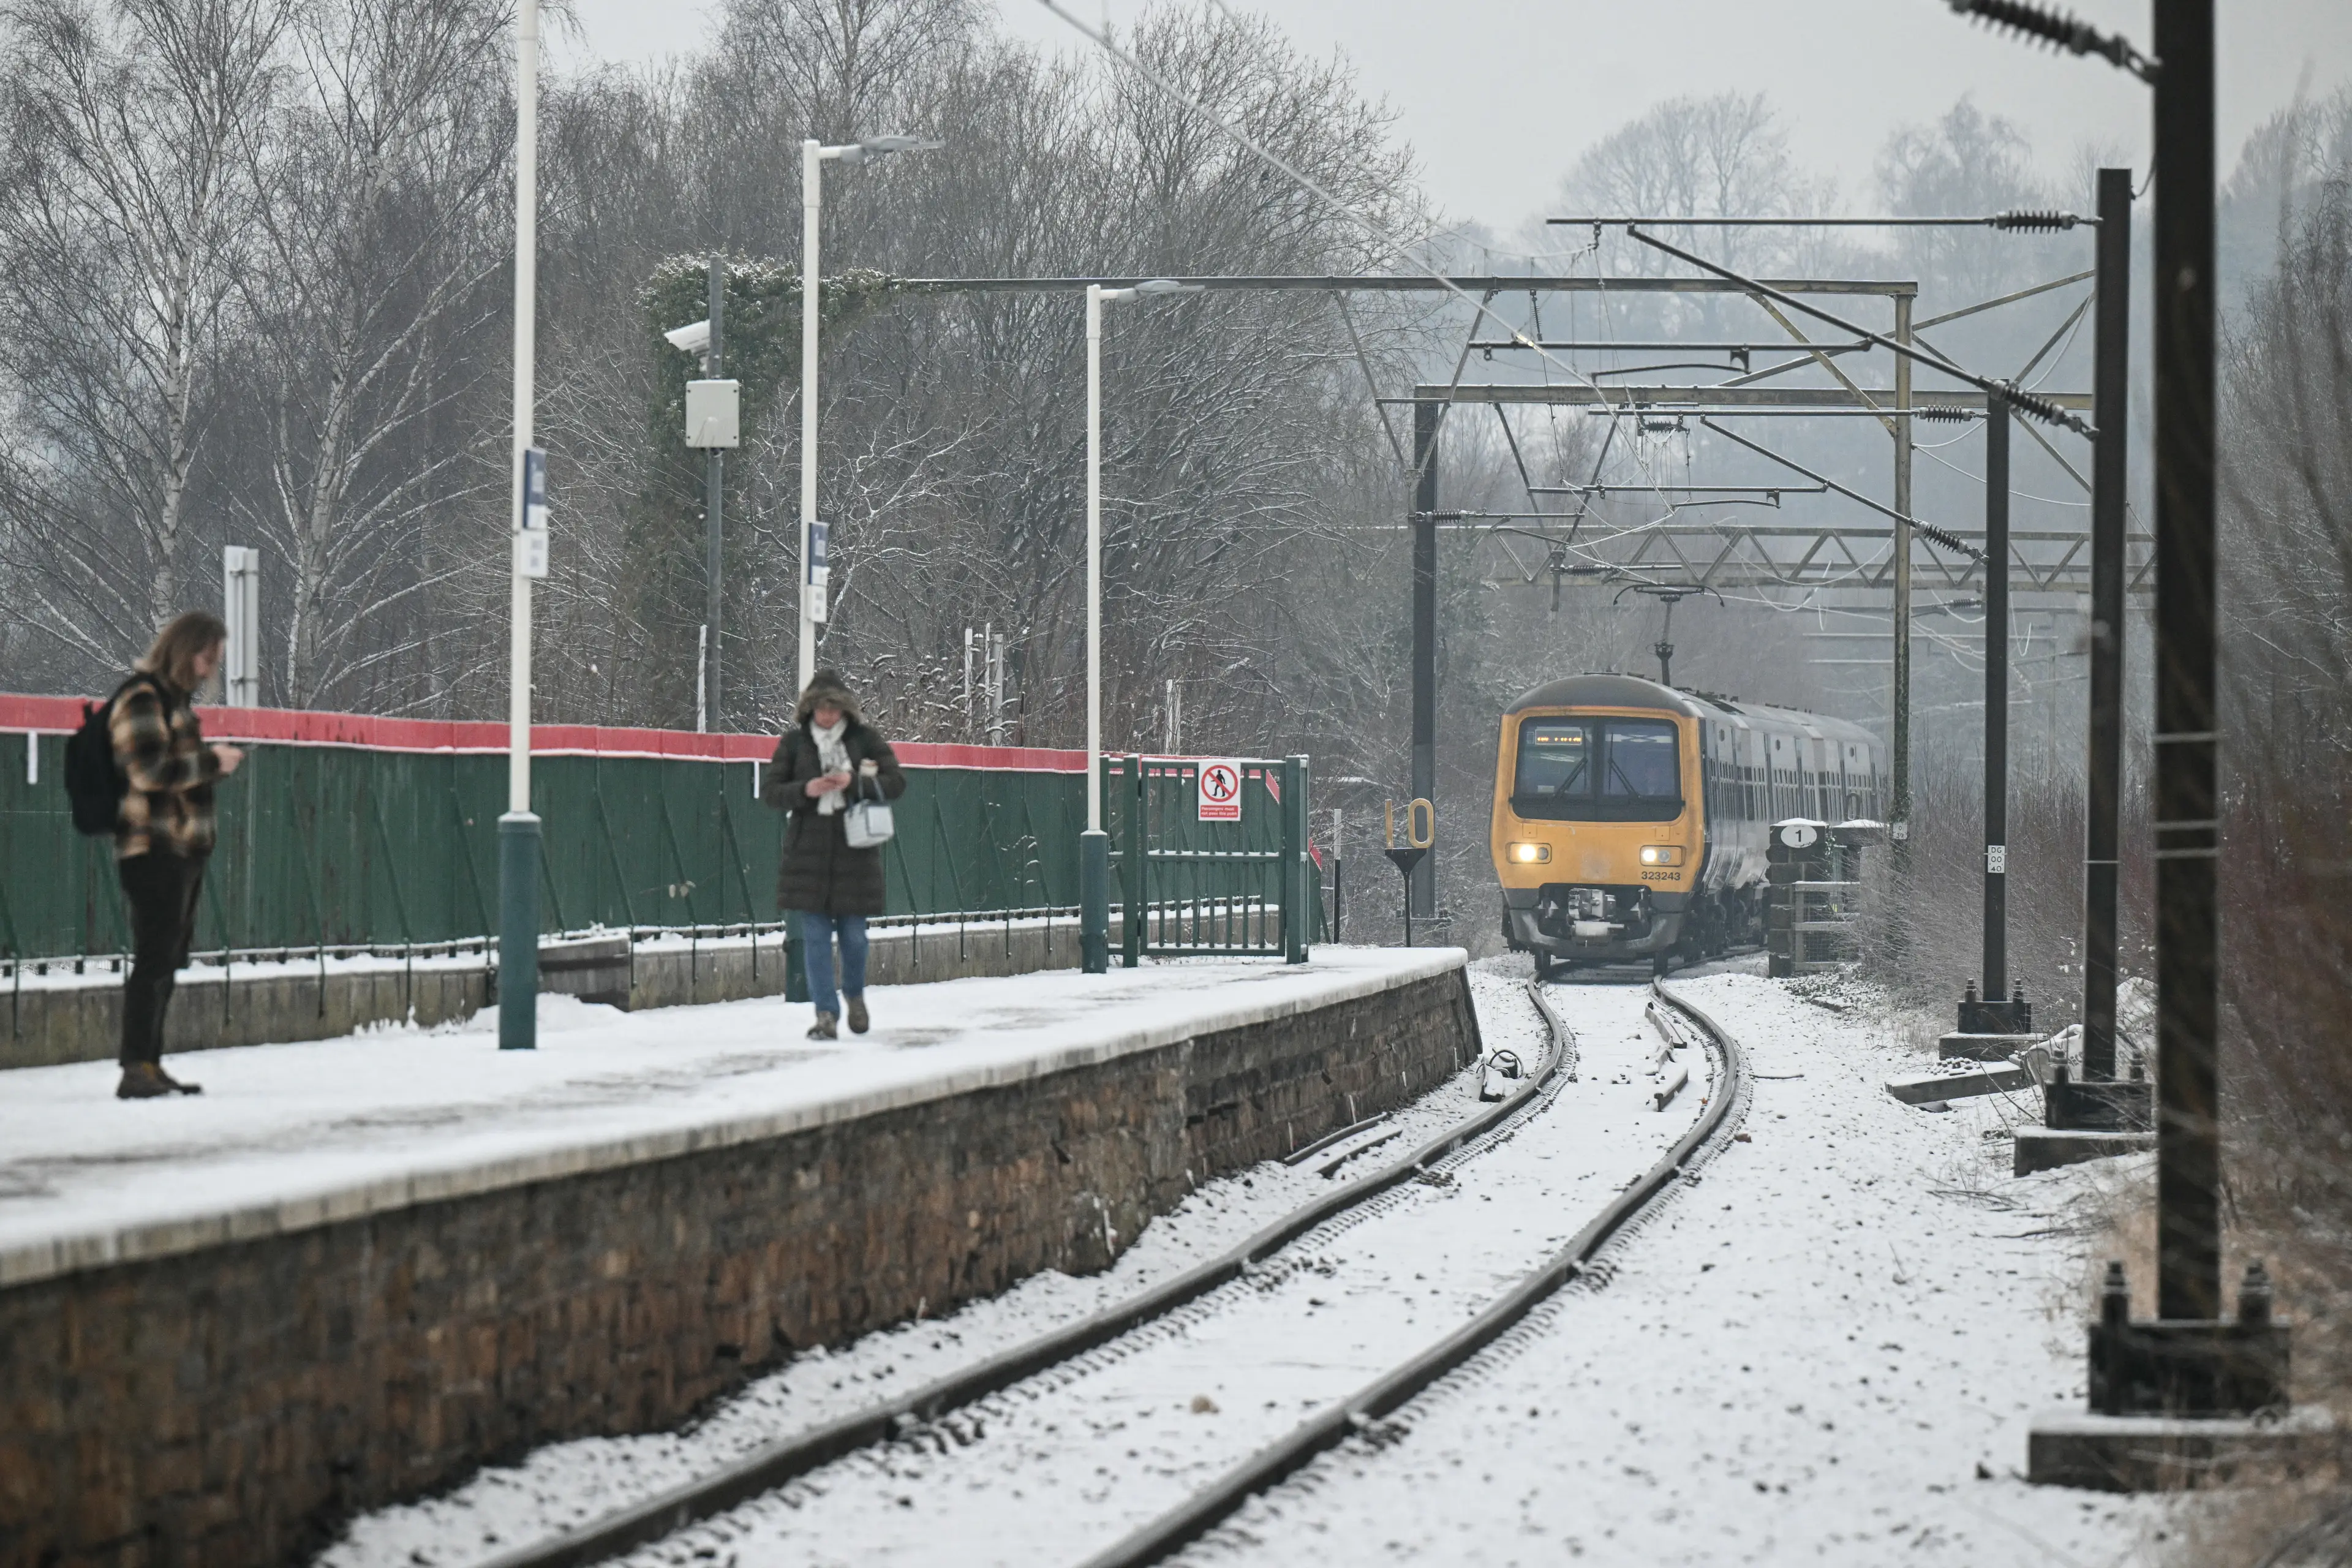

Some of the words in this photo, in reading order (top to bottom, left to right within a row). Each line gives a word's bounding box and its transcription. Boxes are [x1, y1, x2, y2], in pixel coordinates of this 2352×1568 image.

[1385, 798, 1434, 850] 10
[1795, 829, 1801, 842] 1
[1642, 871, 1681, 881] 323243
